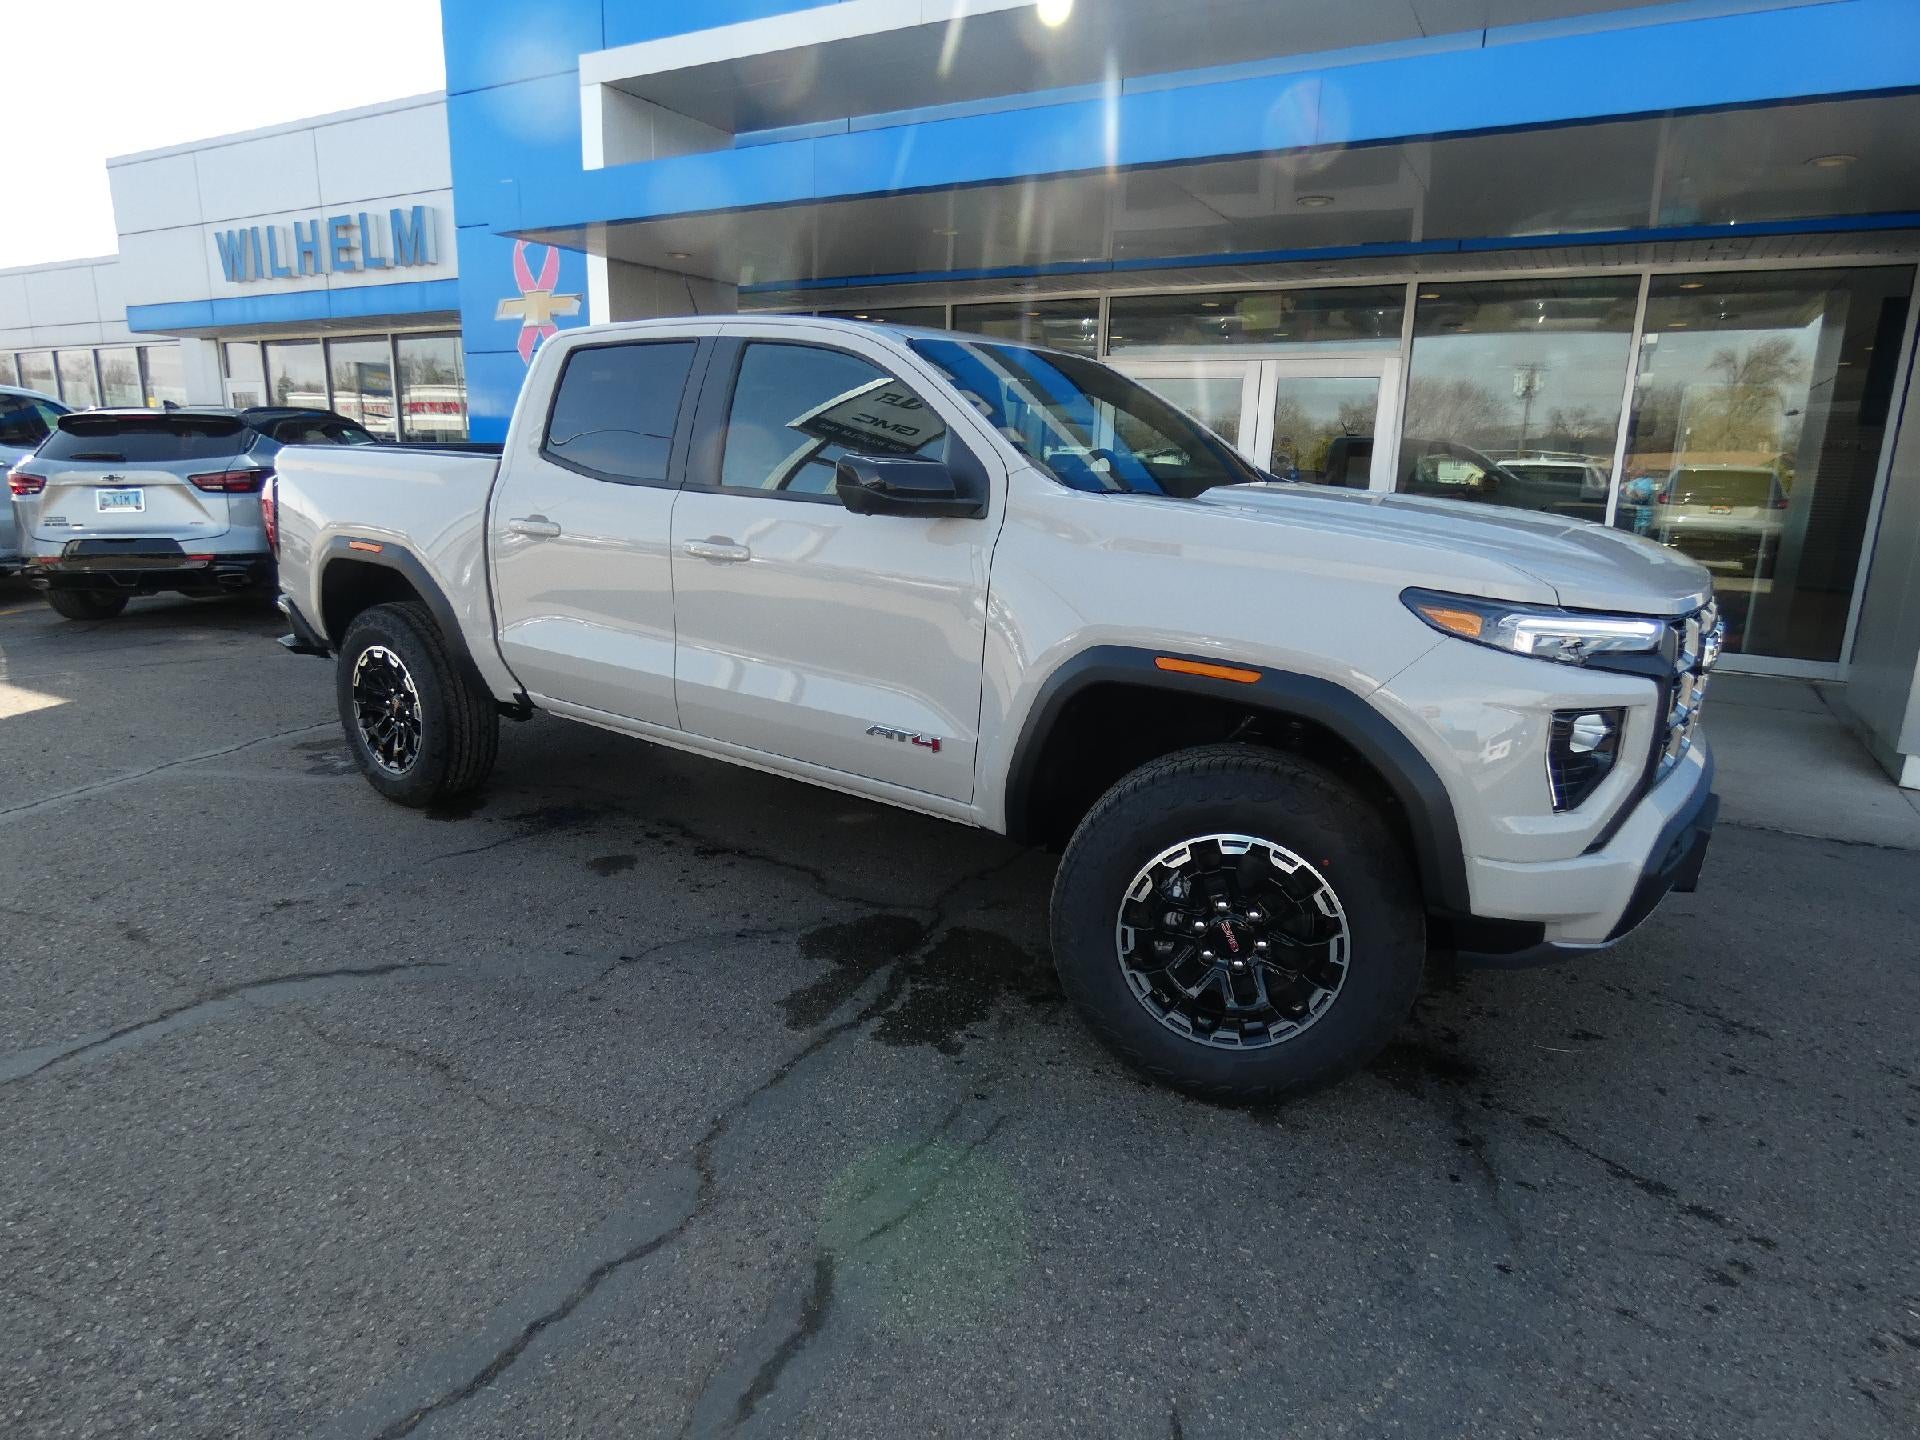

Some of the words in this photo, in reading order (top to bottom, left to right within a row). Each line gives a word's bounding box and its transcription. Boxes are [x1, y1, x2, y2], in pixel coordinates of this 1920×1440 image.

[214, 205, 438, 283] WILHELM
[112, 495, 131, 506] KIM
[865, 724, 943, 754] AT4
